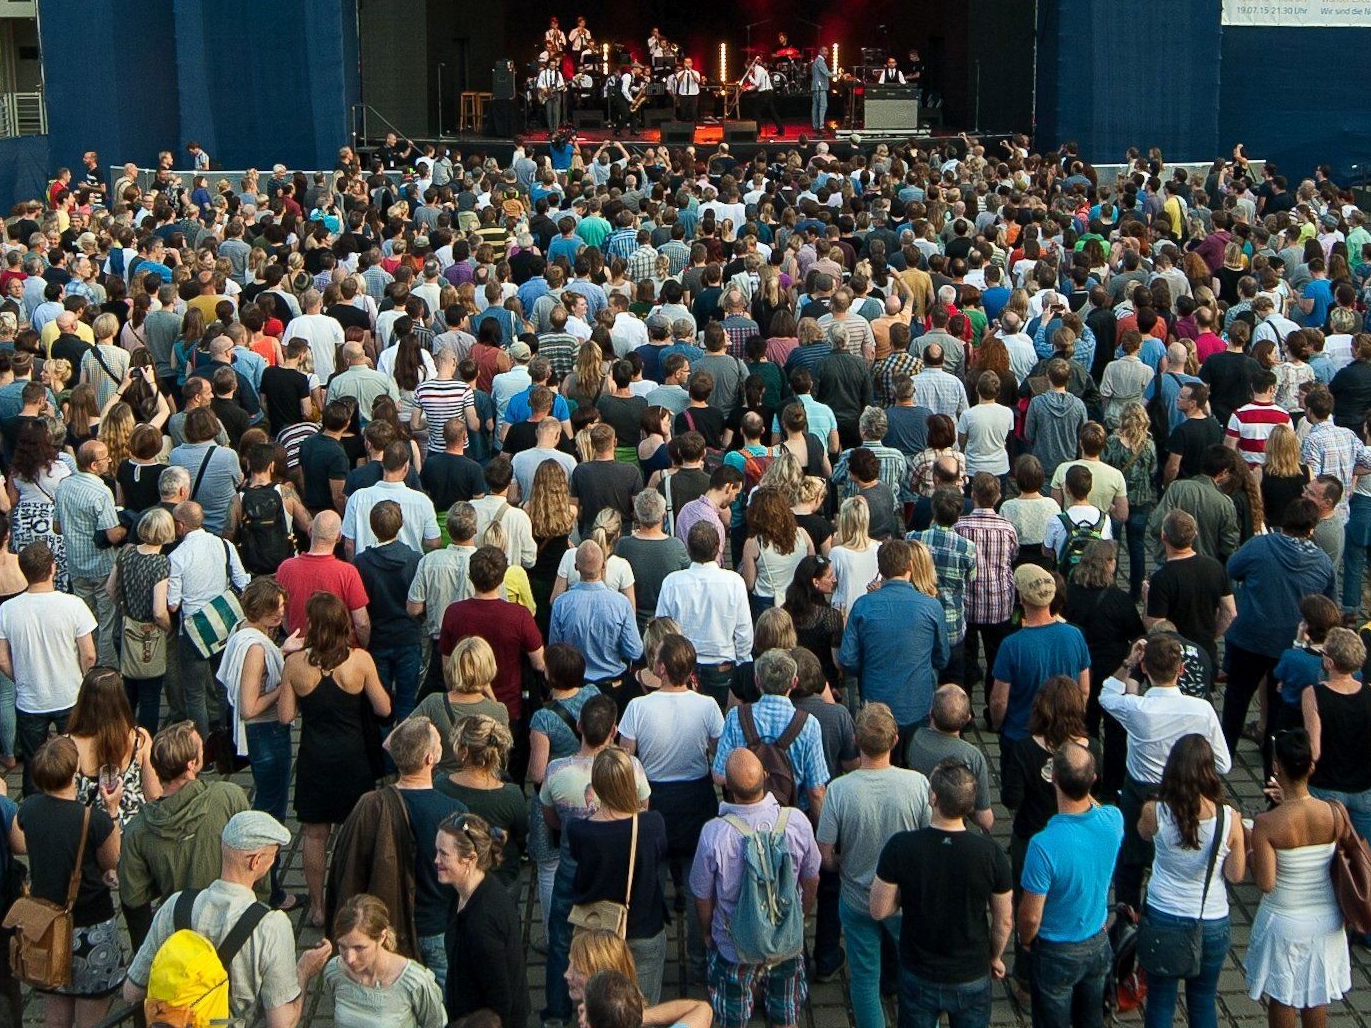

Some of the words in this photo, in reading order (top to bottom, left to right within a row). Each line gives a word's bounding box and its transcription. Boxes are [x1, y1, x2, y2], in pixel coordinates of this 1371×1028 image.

[1236, 6, 1269, 15] 19.07.15
[1271, 7, 1293, 15] 21.30
[1294, 7, 1308, 15] Uhr
[1320, 7, 1333, 15] Wir
[1334, 7, 1350, 15] sind
[1351, 7, 1362, 15] die
